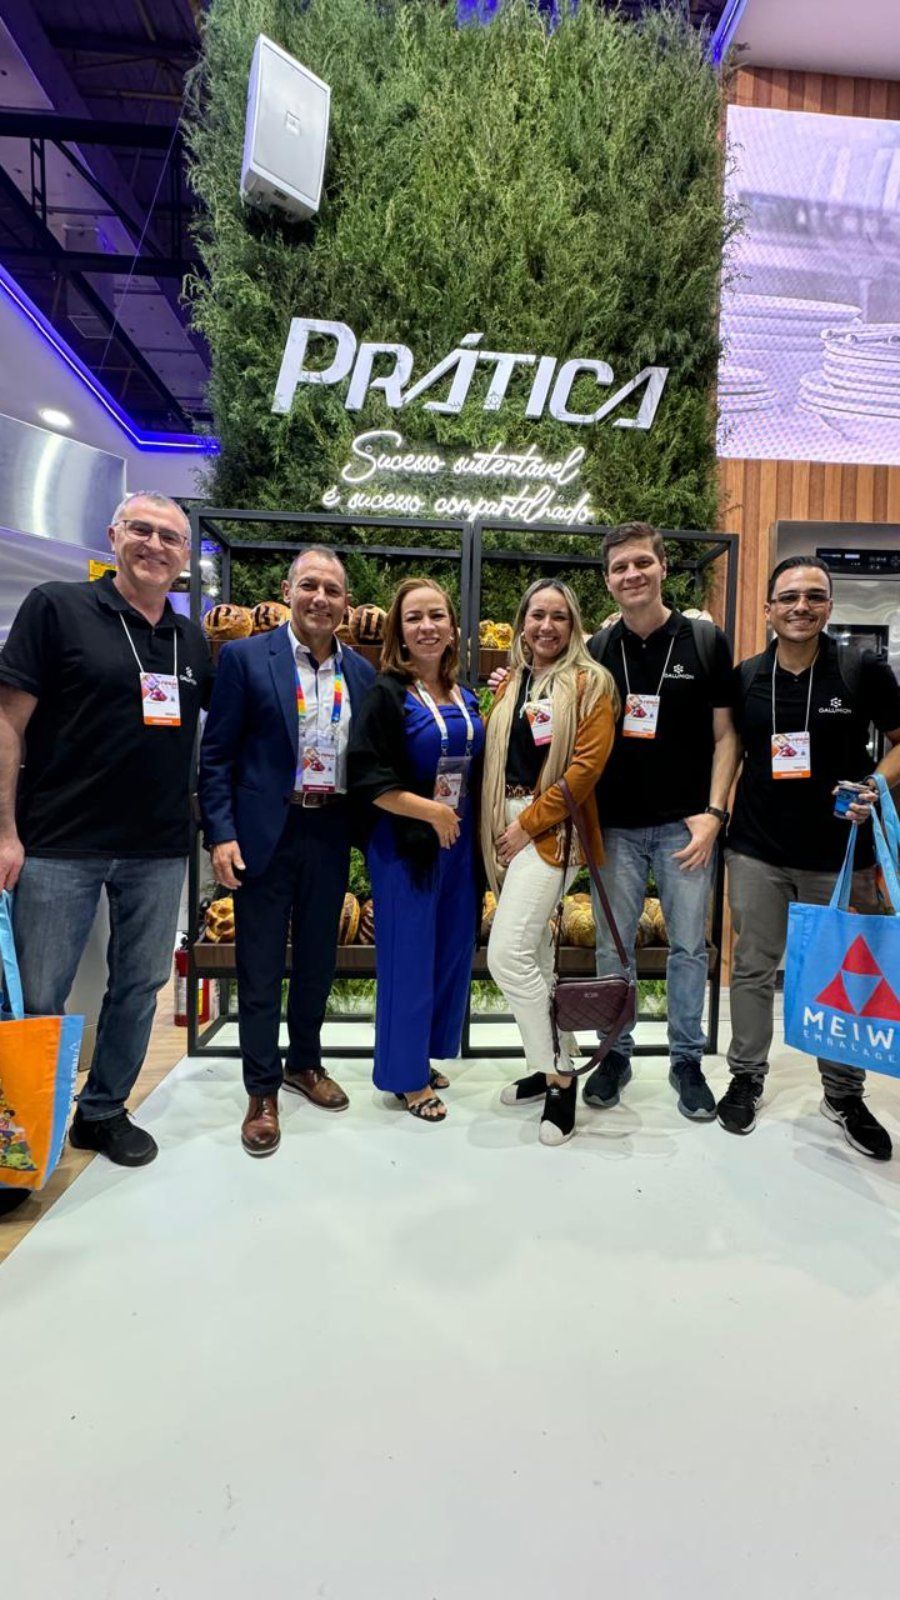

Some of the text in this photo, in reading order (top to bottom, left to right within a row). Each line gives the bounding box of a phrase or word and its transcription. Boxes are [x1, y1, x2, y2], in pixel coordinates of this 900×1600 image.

[271, 317, 670, 429] PRÁTICA
[341, 429, 446, 483] Sucesso
[321, 484, 596, 525] é sucesso compartilhado
[803, 1006, 895, 1050] MEIW
